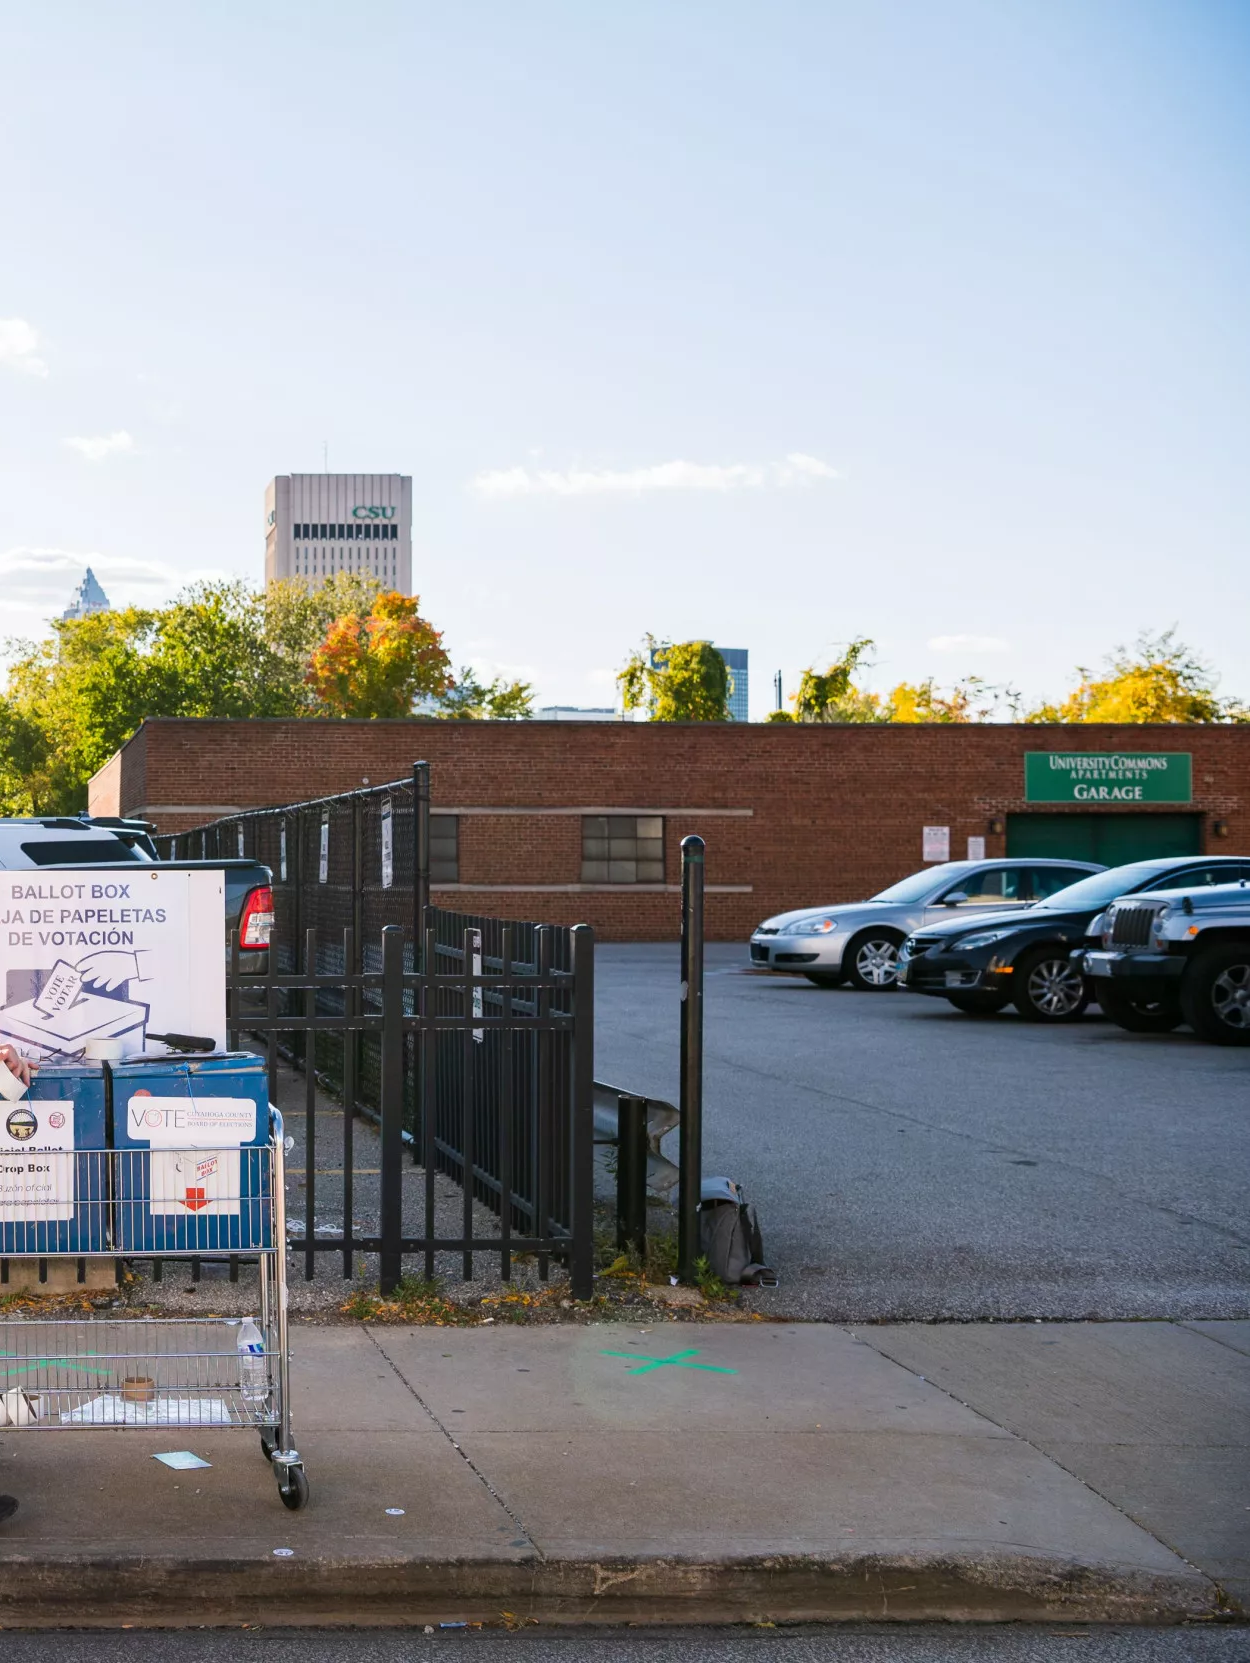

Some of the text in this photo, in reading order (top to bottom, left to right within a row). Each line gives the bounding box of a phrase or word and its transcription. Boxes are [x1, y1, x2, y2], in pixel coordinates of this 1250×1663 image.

[352, 505, 396, 519] CSU
[1070, 769, 1148, 780] APARTMENTS
[1074, 784, 1143, 800] GARAGE
[11, 884, 130, 899] BALLOT BOX
[29, 909, 54, 924] DE
[60, 908, 167, 924] PAPELETAS
[8, 927, 134, 946] DE VOTACIÓN
[44, 975, 65, 1001] VOTE
[52, 975, 78, 1011] VOTAR
[131, 1109, 186, 1128] VOTE
[27, 1163, 51, 1173] Box
